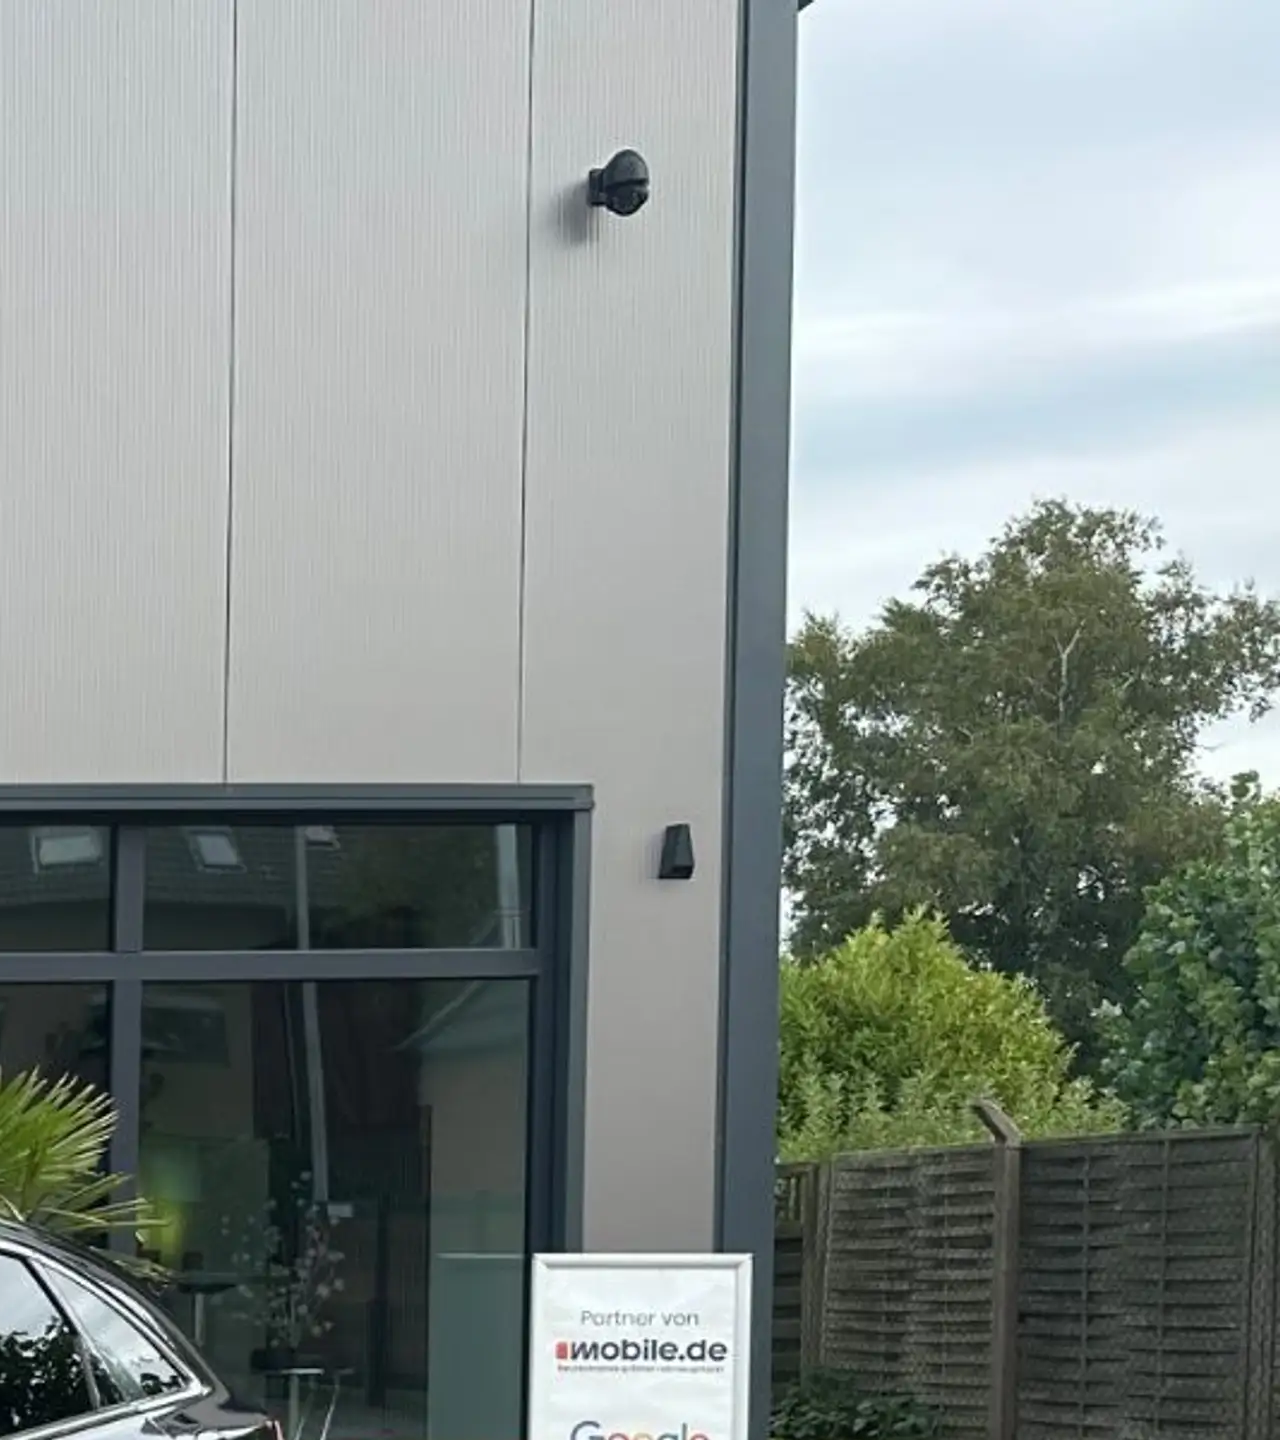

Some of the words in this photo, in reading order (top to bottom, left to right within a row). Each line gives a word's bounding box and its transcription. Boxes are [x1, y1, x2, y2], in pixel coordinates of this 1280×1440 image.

[580, 1309, 657, 1327] Partner
[661, 1312, 699, 1327] von
[570, 1338, 728, 1362] mobile.de
